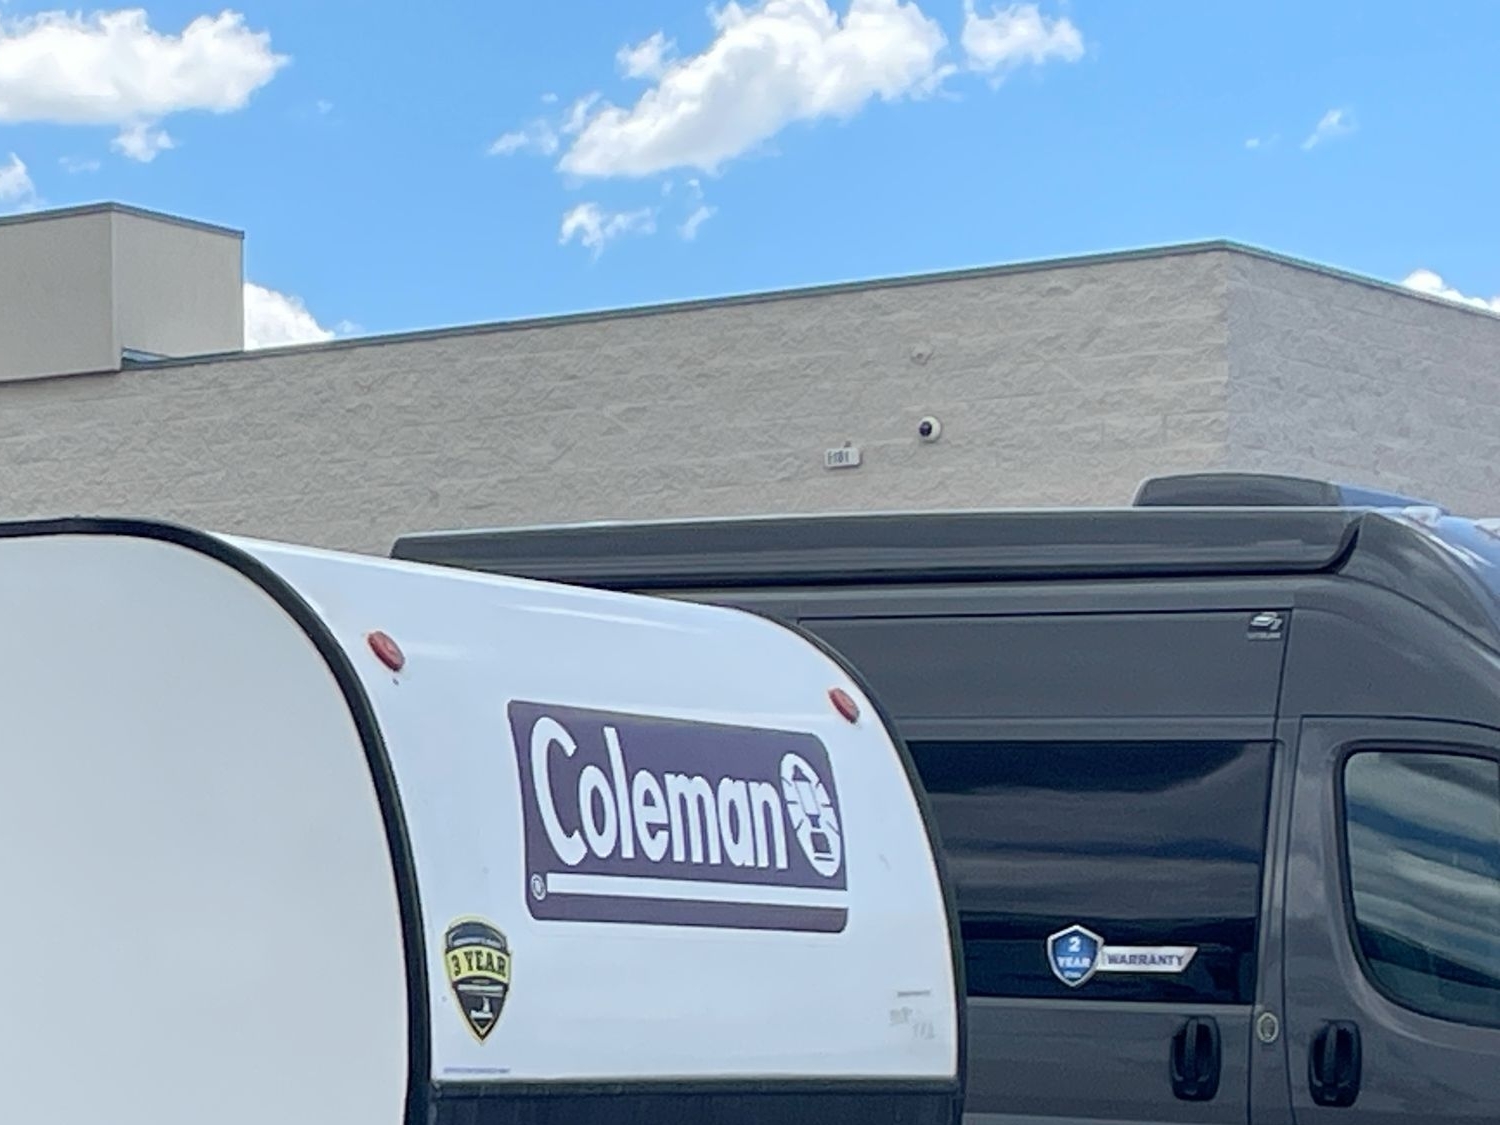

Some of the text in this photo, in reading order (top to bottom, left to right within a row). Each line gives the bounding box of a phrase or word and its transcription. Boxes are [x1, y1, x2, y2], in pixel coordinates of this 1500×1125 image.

[530, 716, 788, 870] Coleman
[1067, 935, 1081, 953] 2
[451, 949, 507, 978] 3 YEAR
[1056, 956, 1091, 968] YEAR
[1107, 953, 1185, 966] WARRANTY
